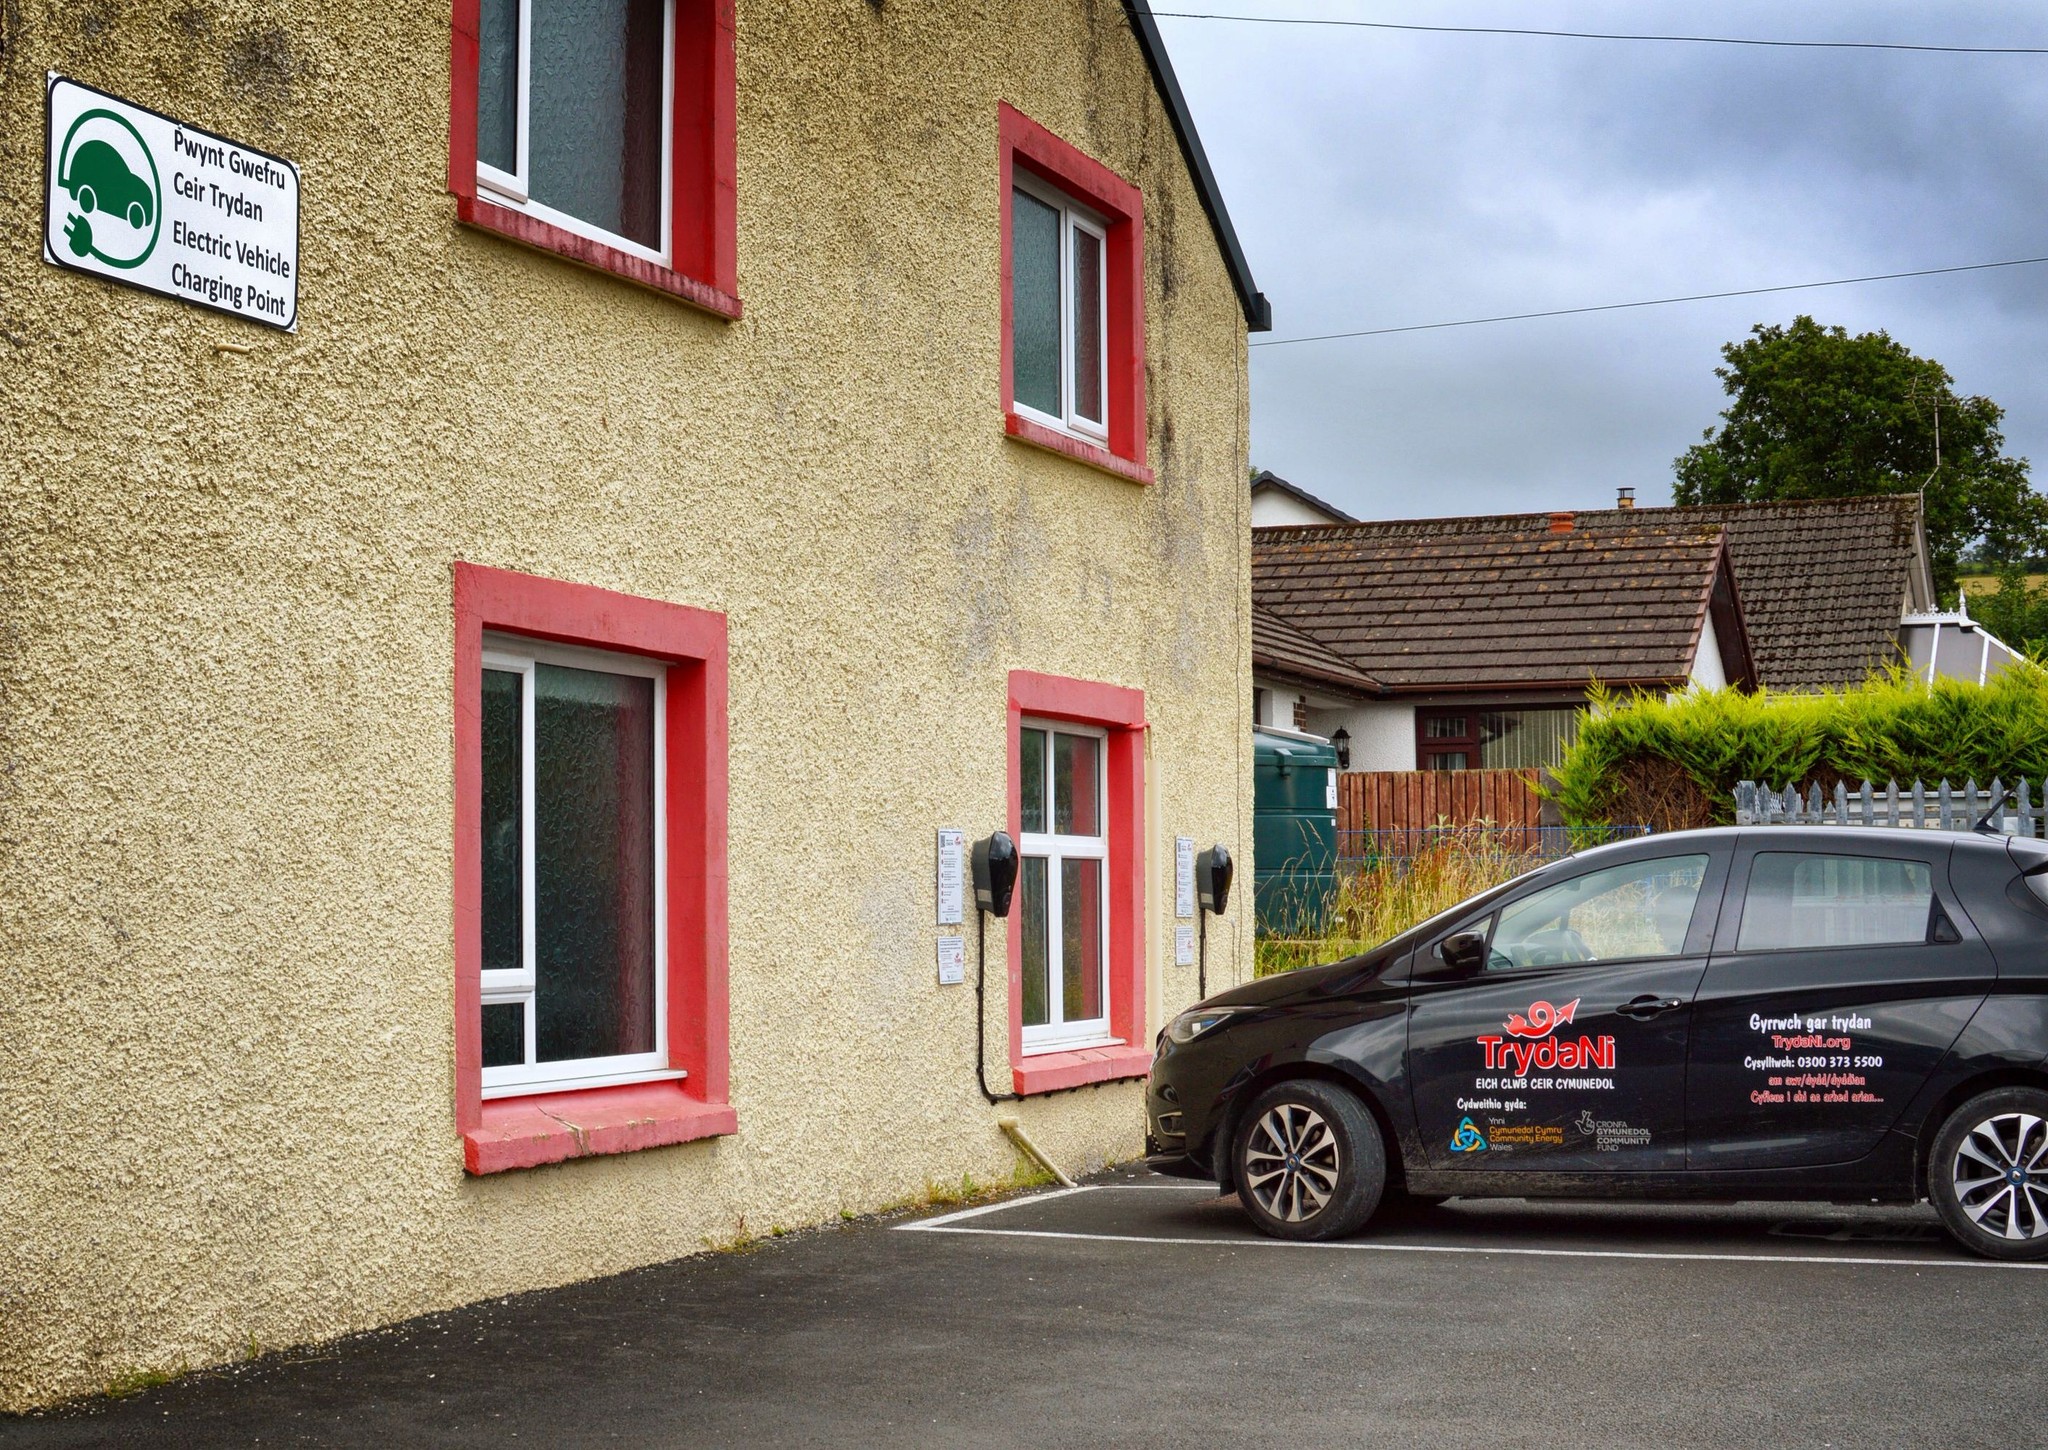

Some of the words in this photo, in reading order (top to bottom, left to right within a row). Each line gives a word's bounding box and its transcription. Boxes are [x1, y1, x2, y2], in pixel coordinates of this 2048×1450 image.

[174, 129, 224, 169] Pwynt
[229, 150, 285, 190] Gwefru
[173, 171, 205, 201] Ceir
[209, 183, 263, 222] Trydan
[173, 220, 232, 260] Electric
[235, 240, 290, 278] Vehicle
[172, 262, 243, 309] Charging
[247, 285, 286, 317] Point
[1749, 1013, 1801, 1034] Gyrrwch
[1806, 1017, 1827, 1033] gar
[1832, 1013, 1871, 1033] trydan
[1771, 1035, 1851, 1050] TrydaNi.org
[1476, 1035, 1616, 1077] TrydaNi
[1744, 1056, 1795, 1070] Cysylltwch:
[1797, 1056, 1826, 1067] 0300
[1829, 1056, 1850, 1067] 373
[1854, 1056, 1883, 1067] 5500
[1476, 1078, 1498, 1089] EICH
[1501, 1078, 1527, 1089] CLWB
[1530, 1078, 1553, 1089] CEIR
[1555, 1078, 1615, 1089] CYMUNEDOL
[1456, 1097, 1502, 1110] Cydweithio
[1504, 1098, 1527, 1111] gyda:
[1488, 1117, 1506, 1125] Ynni
[1489, 1126, 1534, 1136] Cymunedol
[1535, 1126, 1563, 1136] Cymru
[1489, 1134, 1534, 1144] Community
[1535, 1134, 1563, 1144] Energy
[1596, 1137, 1650, 1145] COMMUNITY
[1489, 1143, 1513, 1151] Wales
[1596, 1144, 1619, 1152] FUND
